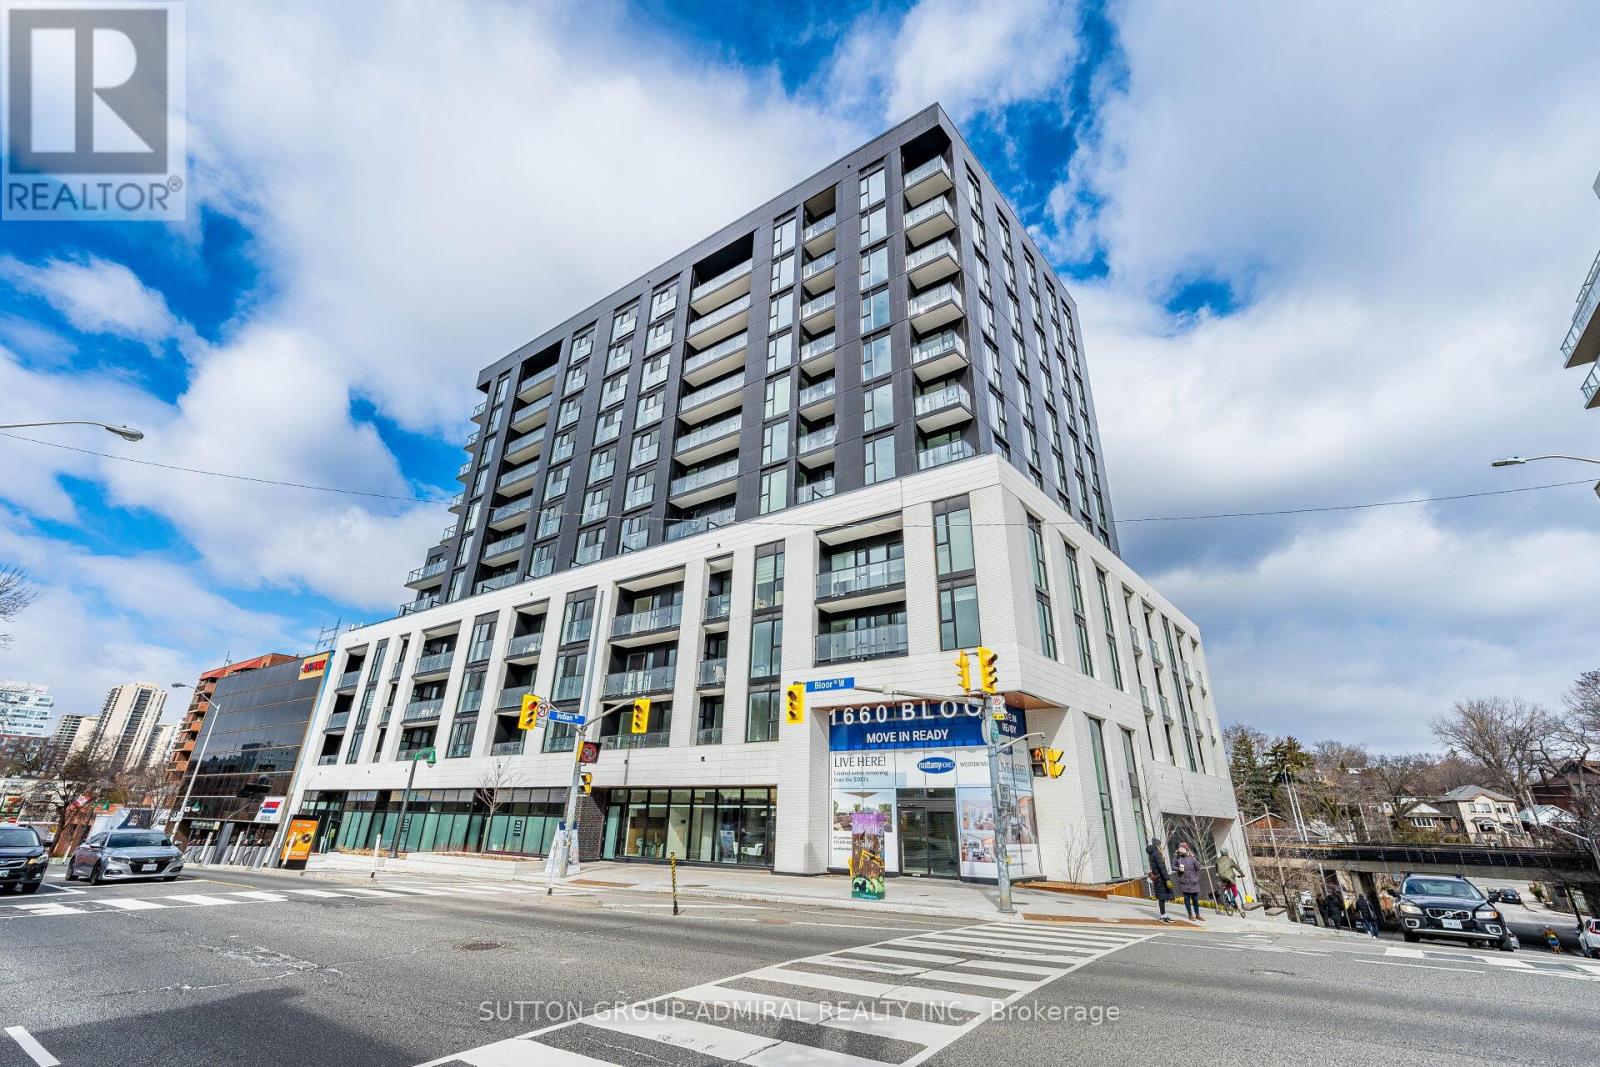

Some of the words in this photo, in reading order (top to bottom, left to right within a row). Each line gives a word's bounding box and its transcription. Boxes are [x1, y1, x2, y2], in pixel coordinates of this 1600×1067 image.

[814, 681, 833, 690] Bloor
[838, 679, 845, 687] W
[829, 705, 887, 726] 1660
[866, 731, 896, 744] MOVE
[898, 731, 910, 742] IN
[912, 728, 949, 742] READY
[834, 757, 855, 768] LIVE
[857, 755, 886, 767] HERE!
